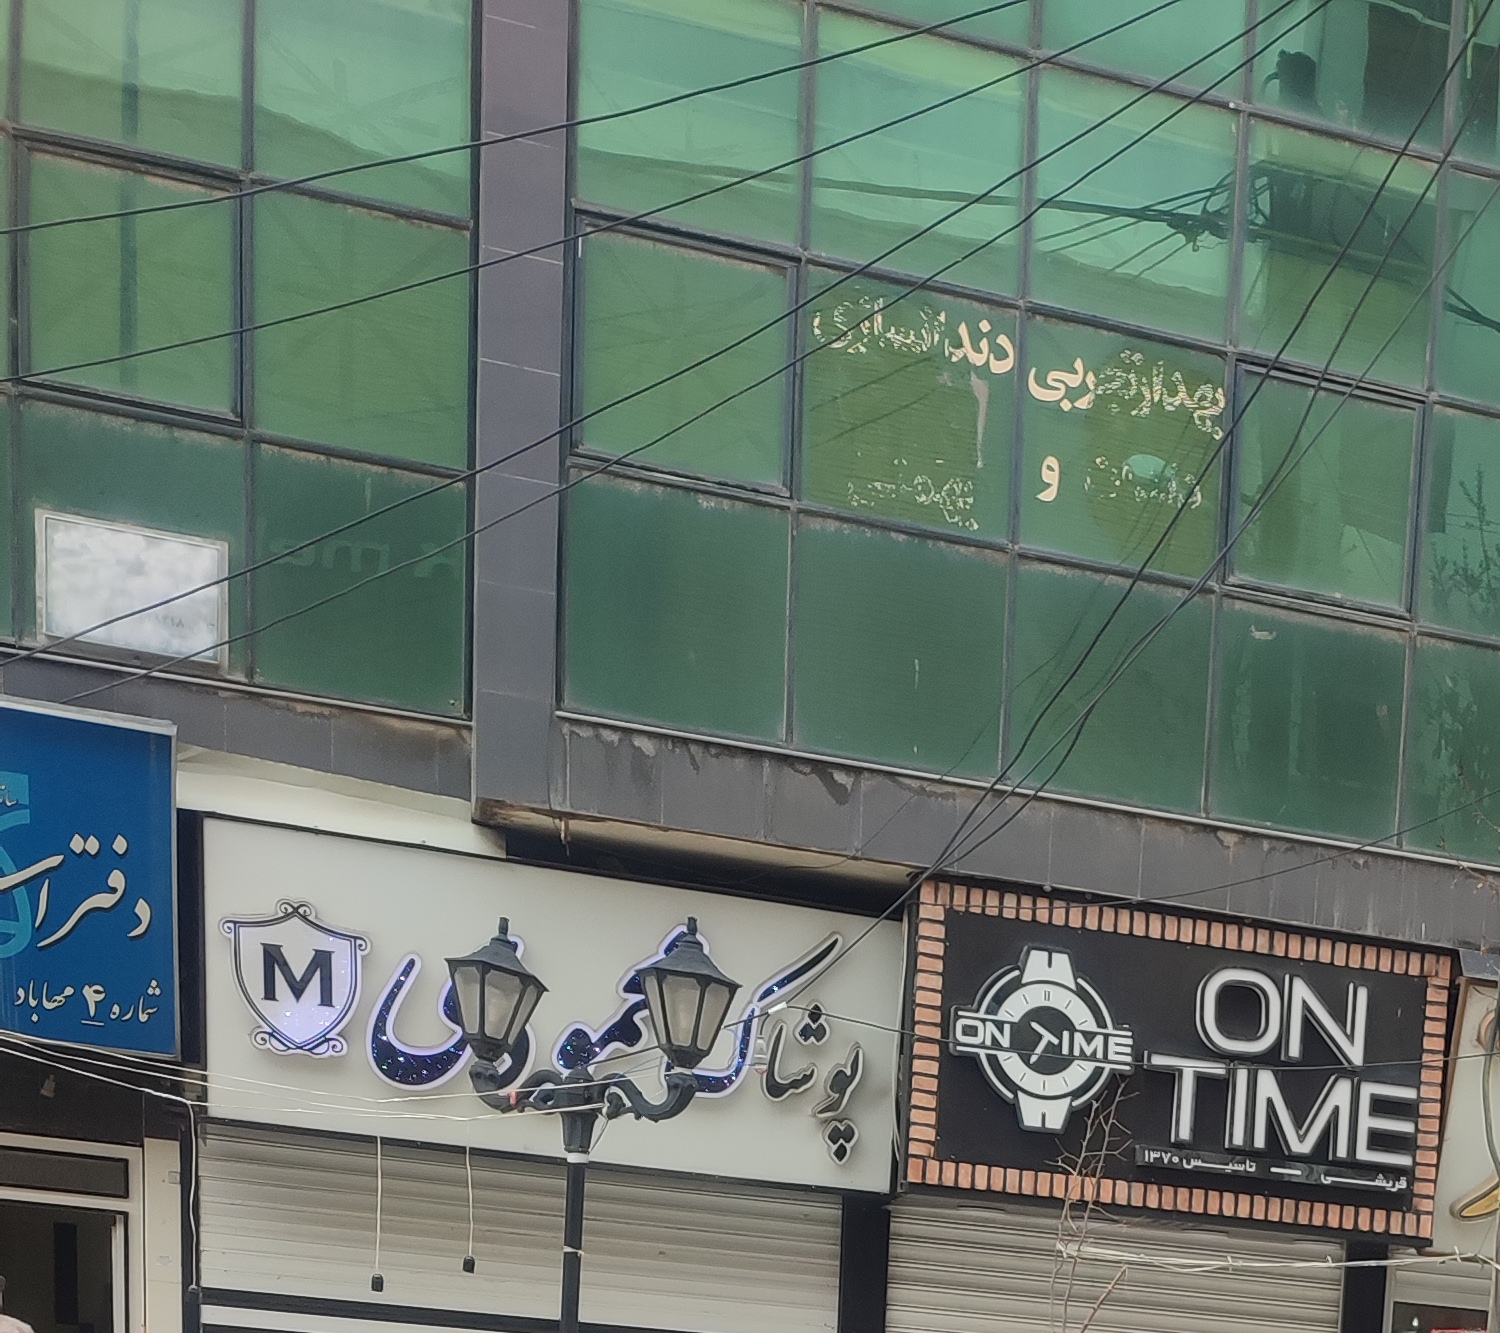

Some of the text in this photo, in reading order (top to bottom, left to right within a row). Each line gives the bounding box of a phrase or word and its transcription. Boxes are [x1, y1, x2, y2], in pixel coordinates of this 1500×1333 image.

[36, 833, 151, 948] دفتر
[14, 979, 75, 1023] مهاباد
[109, 979, 161, 1023] شماره
[260, 942, 334, 1008] M
[954, 1017, 1012, 1049] ON
[1195, 967, 1370, 1068] ON
[1144, 1050, 1419, 1168] TIME
